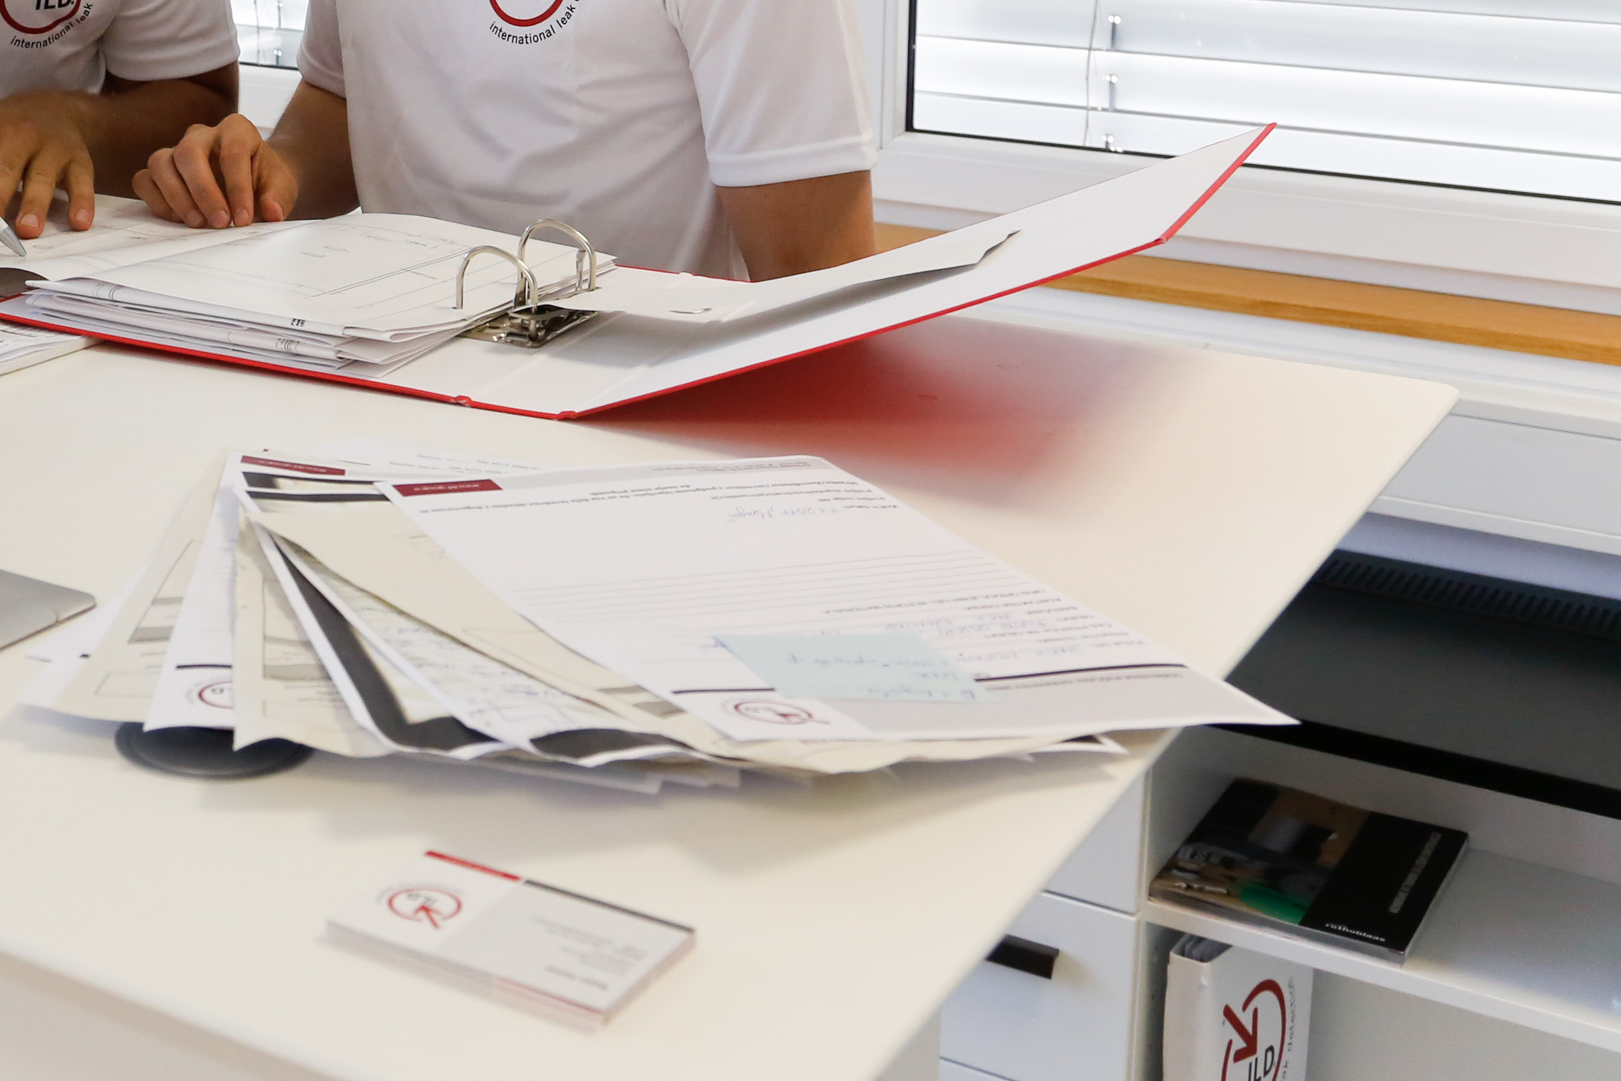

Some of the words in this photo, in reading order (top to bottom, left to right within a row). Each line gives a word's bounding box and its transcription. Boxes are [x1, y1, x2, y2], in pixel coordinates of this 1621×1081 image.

[10, 21, 75, 49] international
[75, 2, 93, 25] leak
[489, 21, 557, 45] international
[556, 4, 576, 28] leak
[1247, 1044, 1274, 1081] ILD
